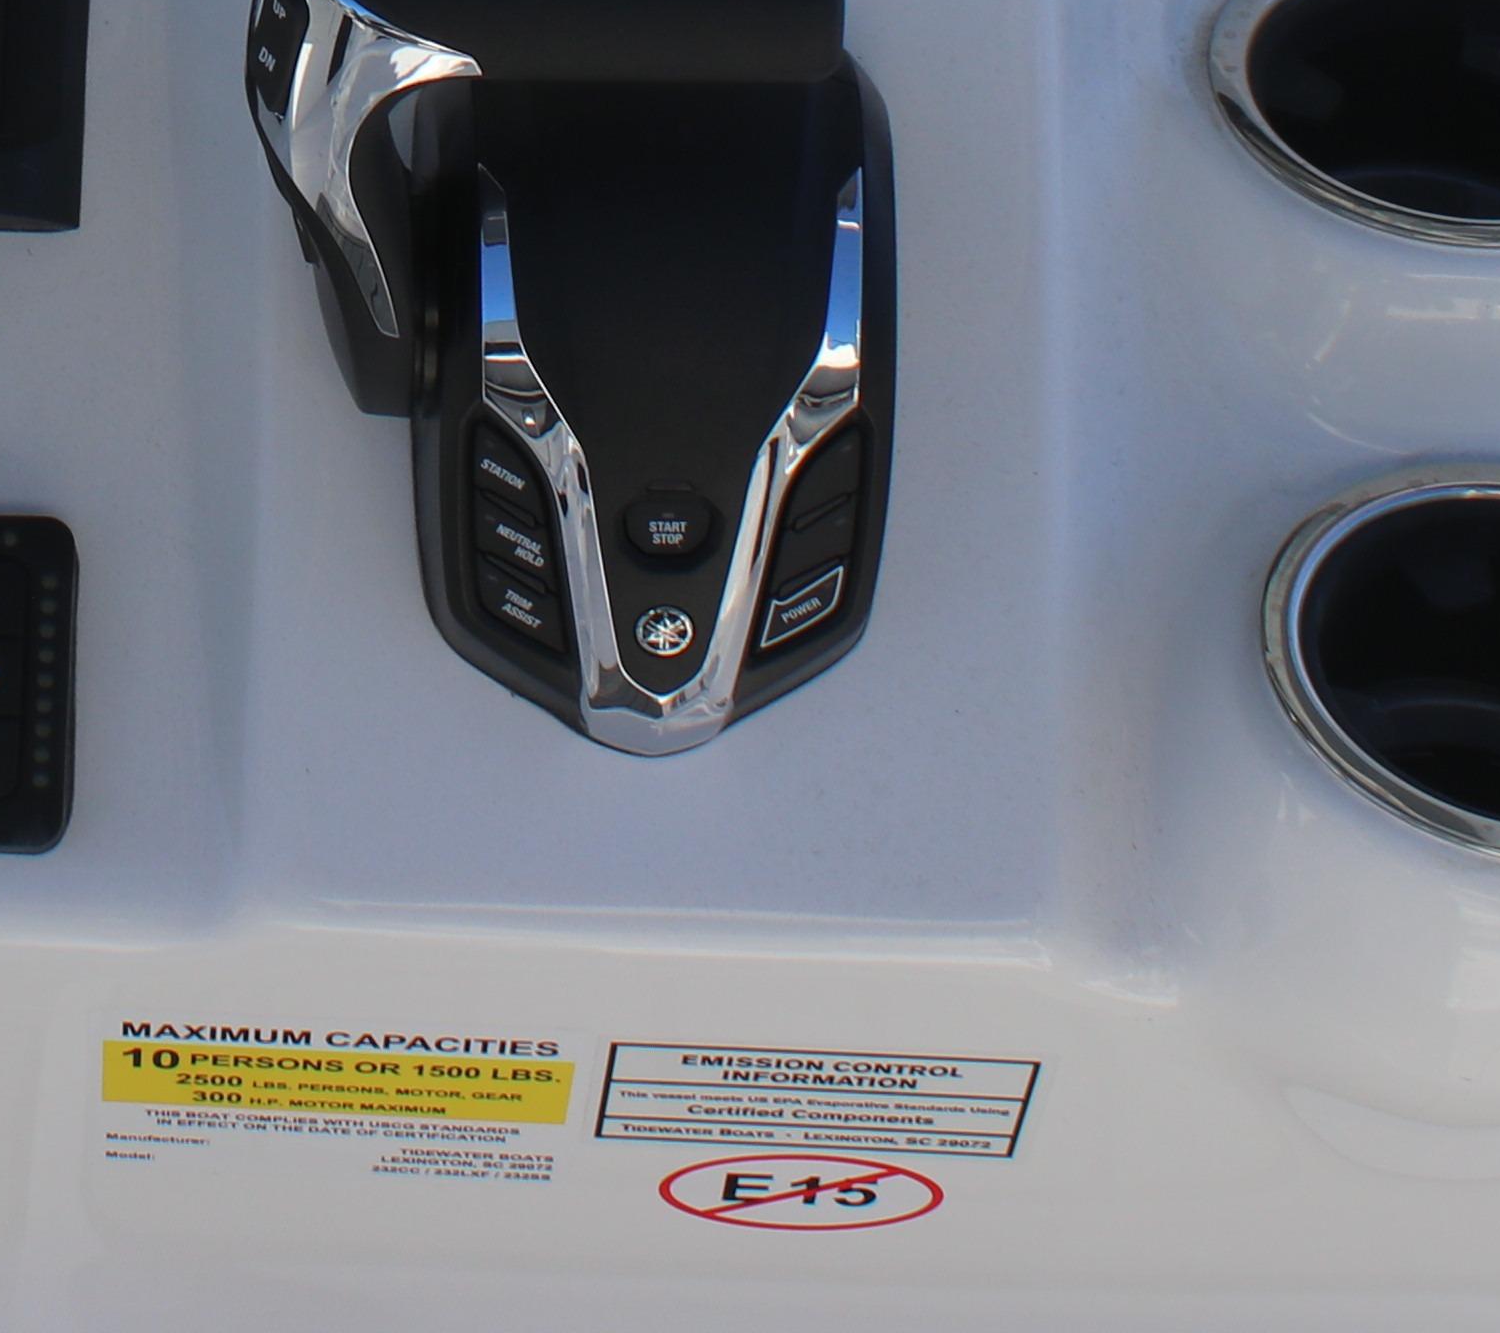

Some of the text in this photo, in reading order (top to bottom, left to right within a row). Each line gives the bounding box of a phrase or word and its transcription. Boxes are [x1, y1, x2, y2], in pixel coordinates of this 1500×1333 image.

[258, 46, 276, 72] DN
[480, 458, 525, 491] STATION
[648, 520, 688, 533] START
[496, 524, 542, 555] NEUTRAL
[652, 532, 684, 546] STOP
[515, 545, 545, 568] HOLD
[504, 589, 534, 611] TRIM
[780, 596, 823, 624] POWER
[501, 603, 543, 629] ASSIST
[121, 1021, 560, 1056] MAXIMUM CAPACITIES
[122, 1047, 562, 1083] 10 PERSONS OR 1500 LBS.
[681, 1054, 964, 1078] EMISSION CONTROL
[176, 1073, 243, 1087] 2500
[252, 1080, 292, 1091] LBS.
[472, 1092, 523, 1102] GEAR
[722, 1070, 918, 1089] INFORMATION
[192, 1091, 447, 1115] 300 H.P. MOTOR MAXIMUM
[620, 1090, 649, 1099] This
[652, 1093, 696, 1101] vessel
[700, 1095, 743, 1103] meets
[748, 1096, 769, 1104] US
[772, 1097, 803, 1106] EPA
[806, 1098, 889, 1111] Evaporative
[894, 1102, 966, 1114] Standards
[145, 1108, 520, 1136] THIS BOAT COMPLIES WITH USCG STANDARDS
[687, 1104, 934, 1126] Certified Components
[105, 1132, 210, 1146] Manufacturer:
[156, 1117, 506, 1143] IN EFFECT ON THE DATE OF CERTIFICATION
[905, 1136, 931, 1146] SC
[937, 1138, 991, 1149] 29072
[105, 1151, 155, 1161] Model:
[400, 1147, 554, 1163] TIDEWATER BOATS
[483, 1160, 504, 1169] SC
